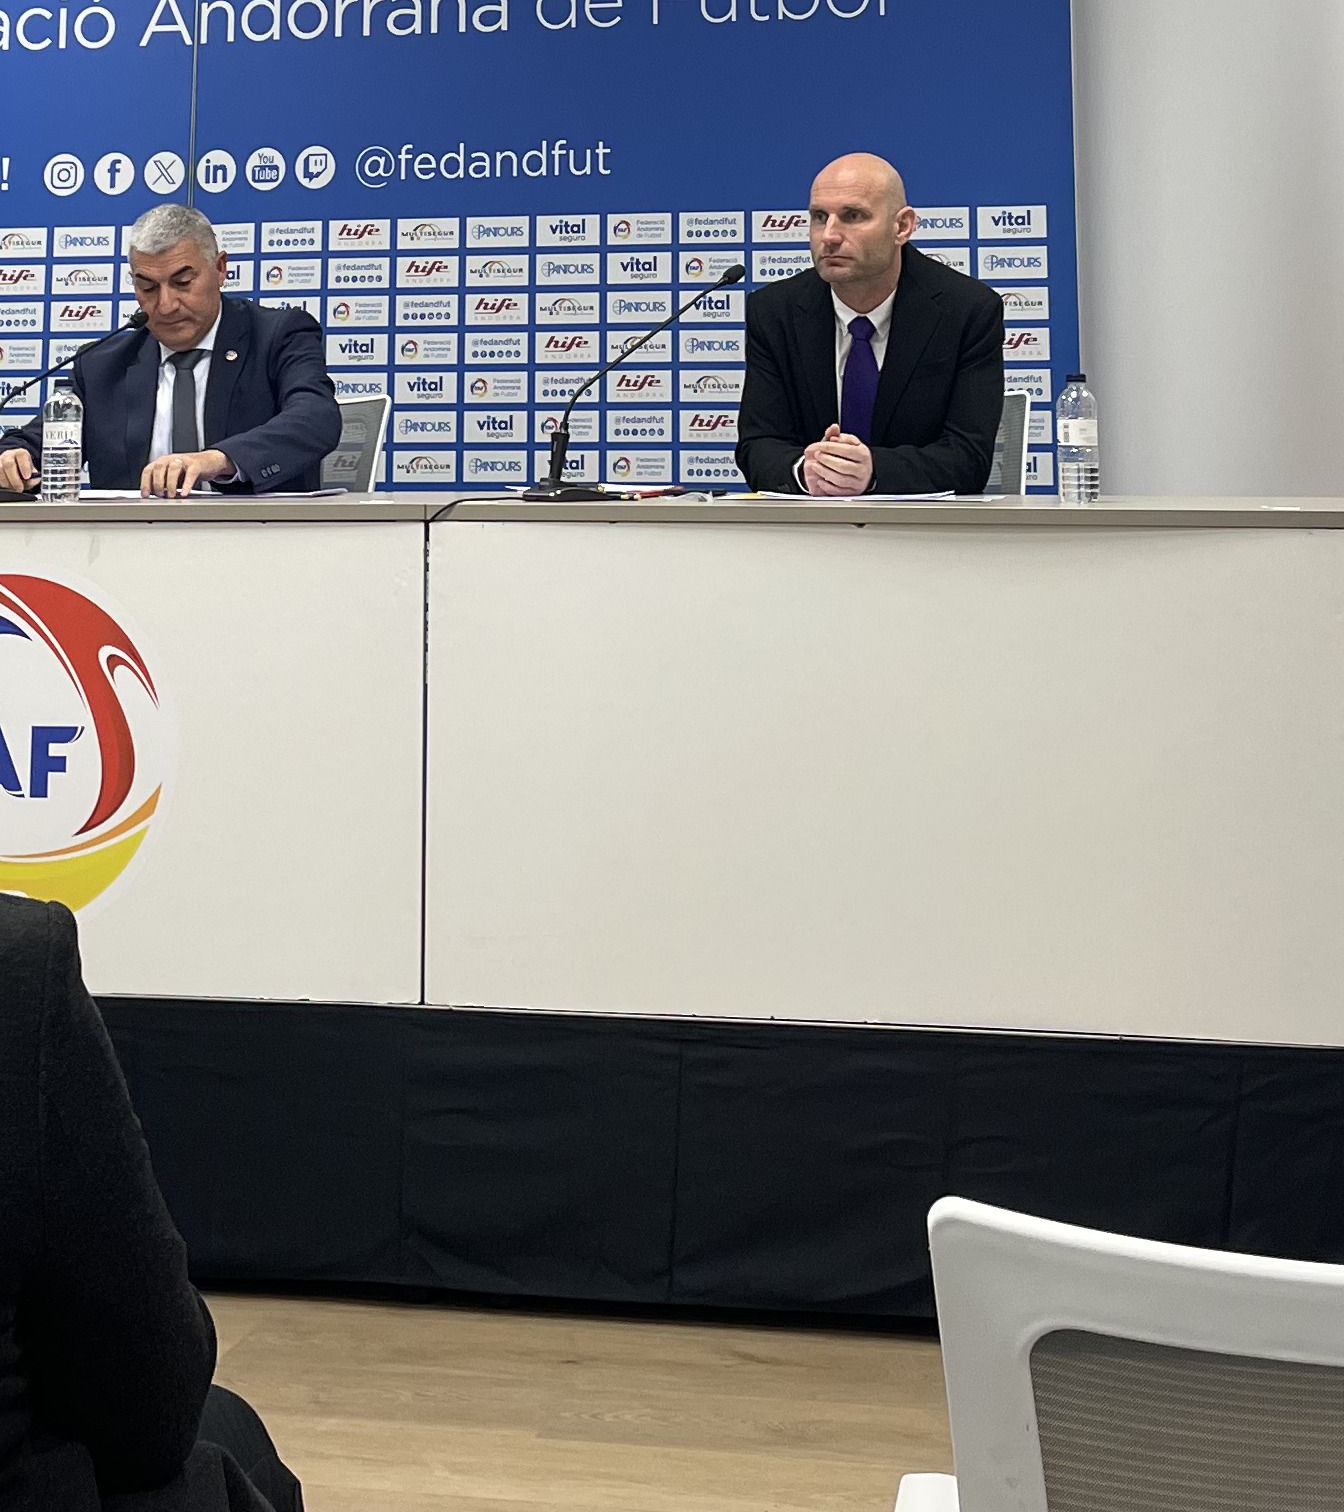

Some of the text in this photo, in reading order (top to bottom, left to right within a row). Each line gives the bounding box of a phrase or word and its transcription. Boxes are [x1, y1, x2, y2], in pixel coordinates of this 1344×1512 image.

[356, 139, 611, 188] @fedandfut
[992, 209, 1031, 226] vital
[549, 219, 586, 234] vital
[621, 256, 657, 271] vital
[339, 338, 374, 353] vital
[1003, 332, 1036, 349] ife
[407, 376, 443, 391] vital
[477, 415, 513, 430] vital
